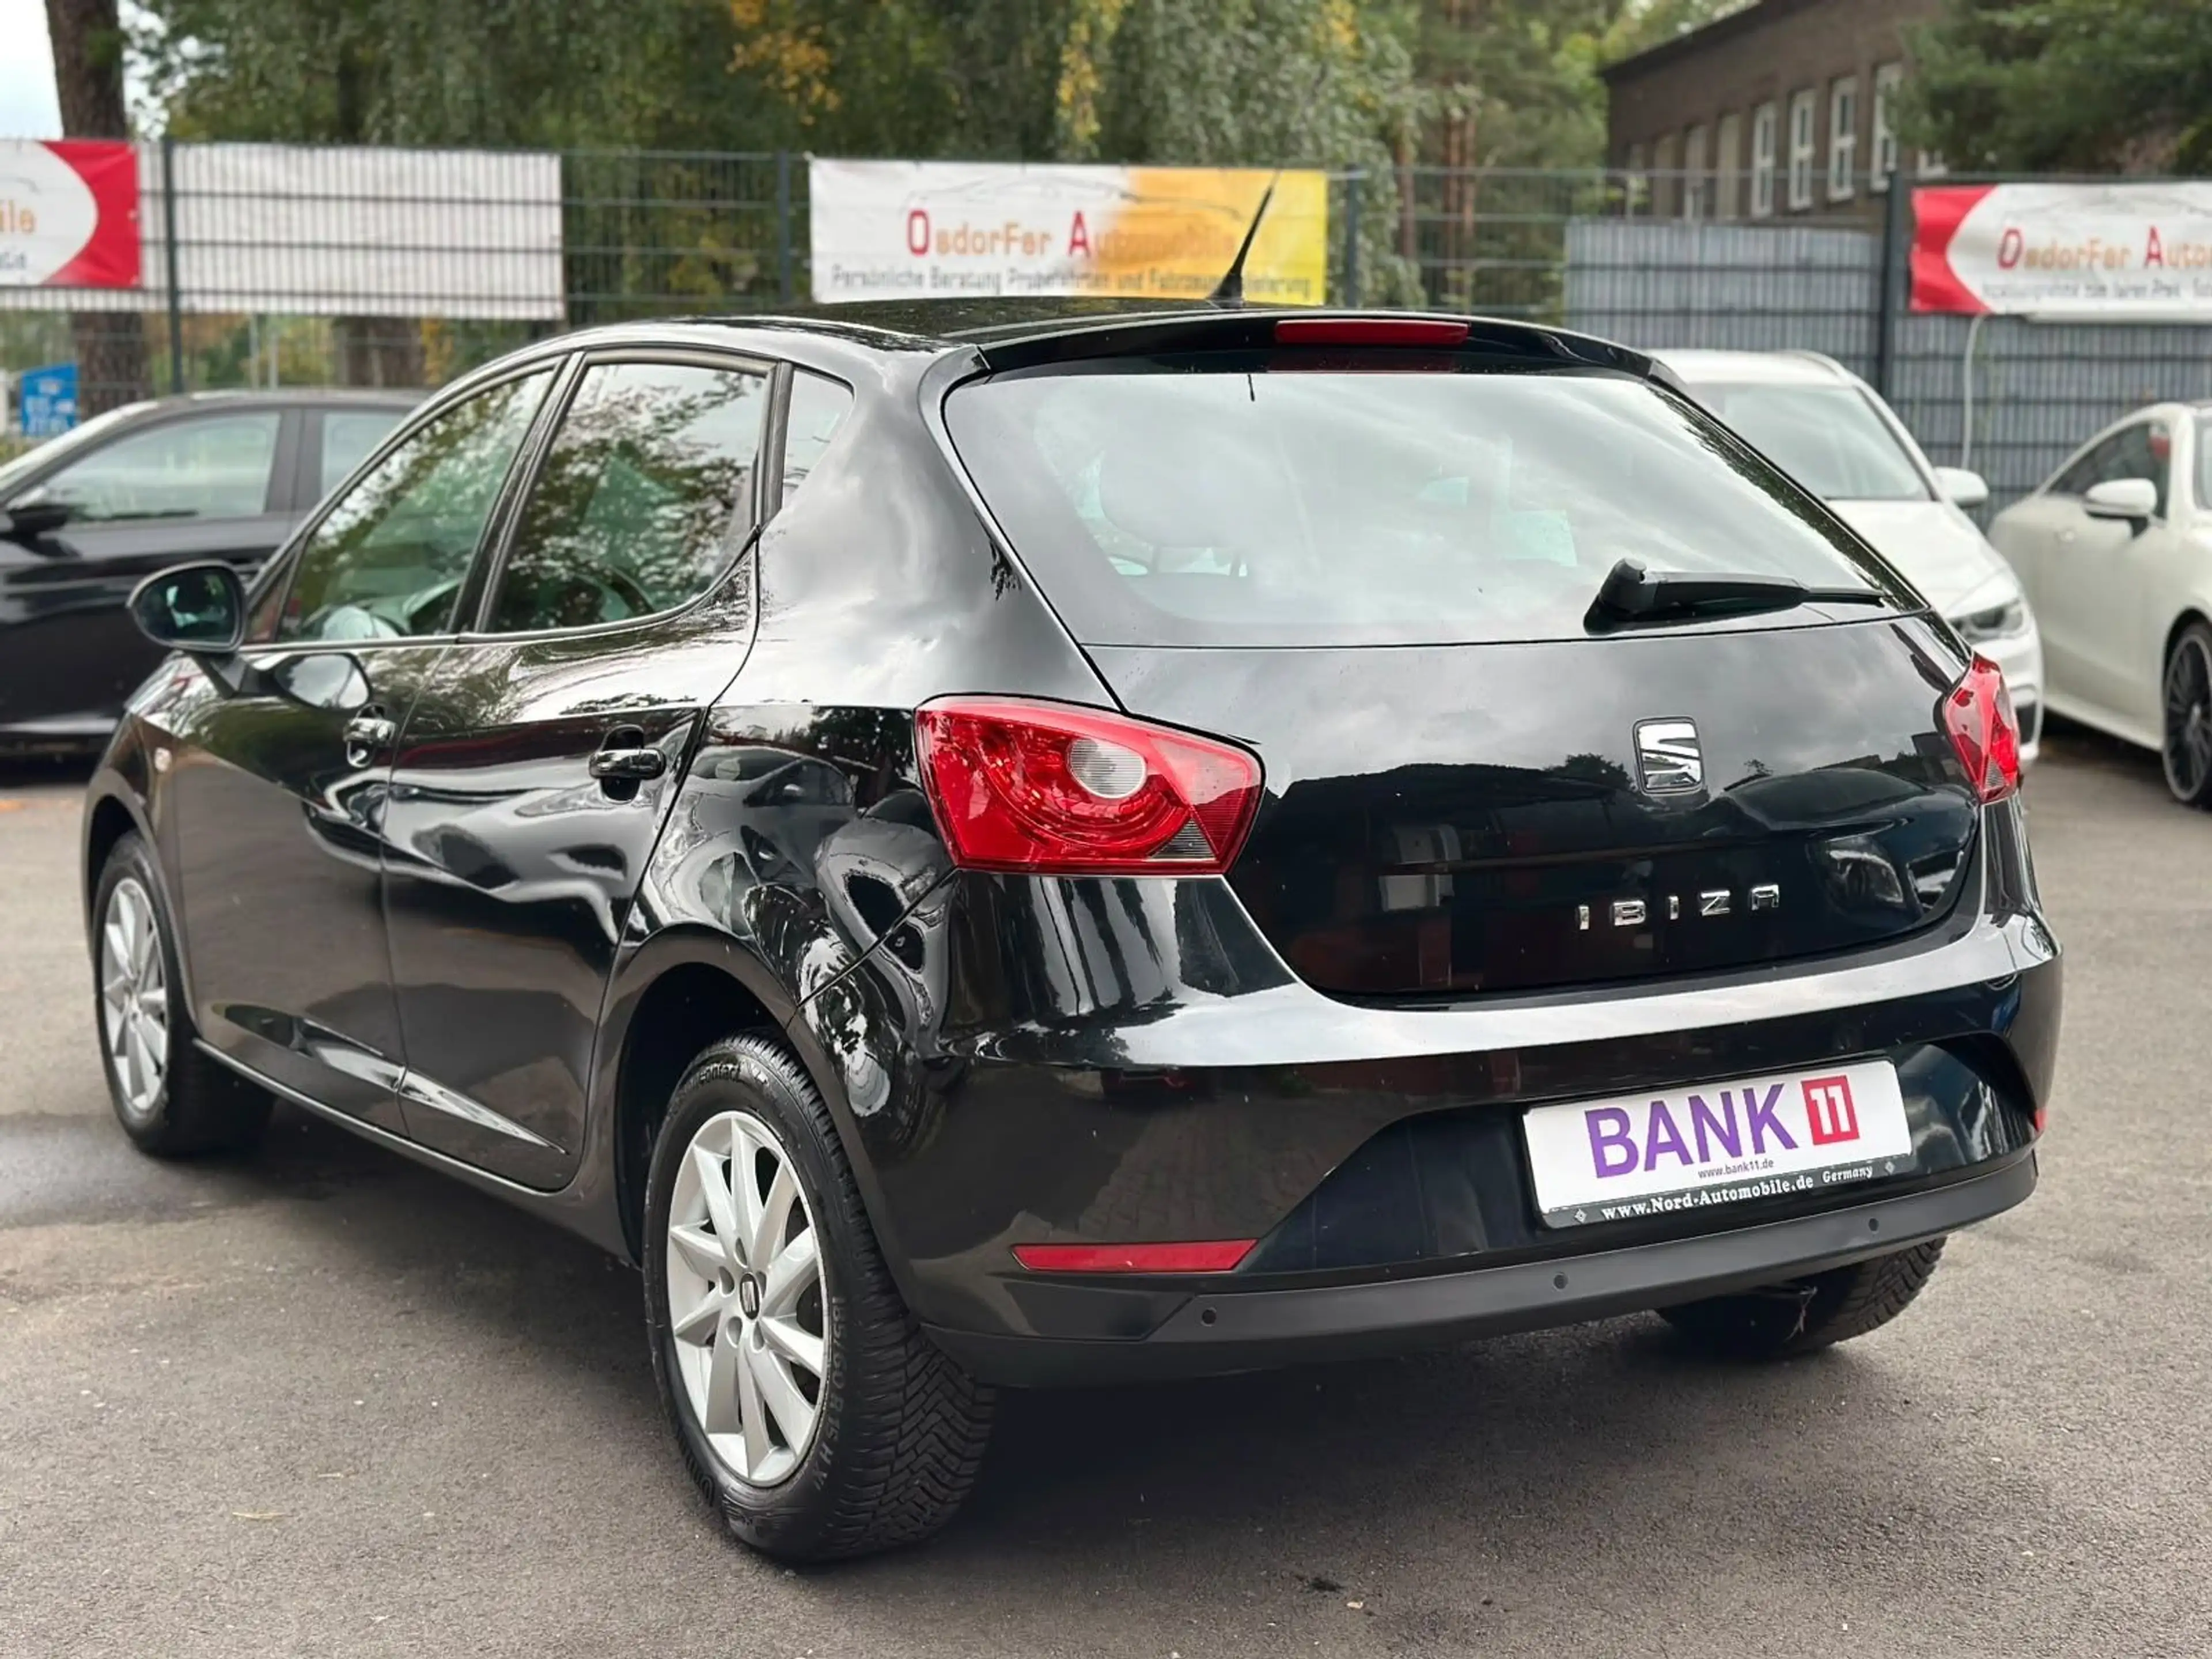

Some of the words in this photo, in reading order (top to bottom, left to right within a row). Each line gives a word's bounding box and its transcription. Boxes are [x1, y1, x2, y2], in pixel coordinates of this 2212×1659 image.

[2142, 225, 2212, 270] Auto
[1578, 884, 1779, 930] IBIZA
[1585, 1083, 1798, 1179] BANK
[1808, 1082, 1854, 1138] 11
[1698, 1158, 1774, 1179] www.bank11.de
[1601, 1175, 1814, 1221] www.Nord-Automobile.de
[1822, 1165, 1873, 1184] Germany
